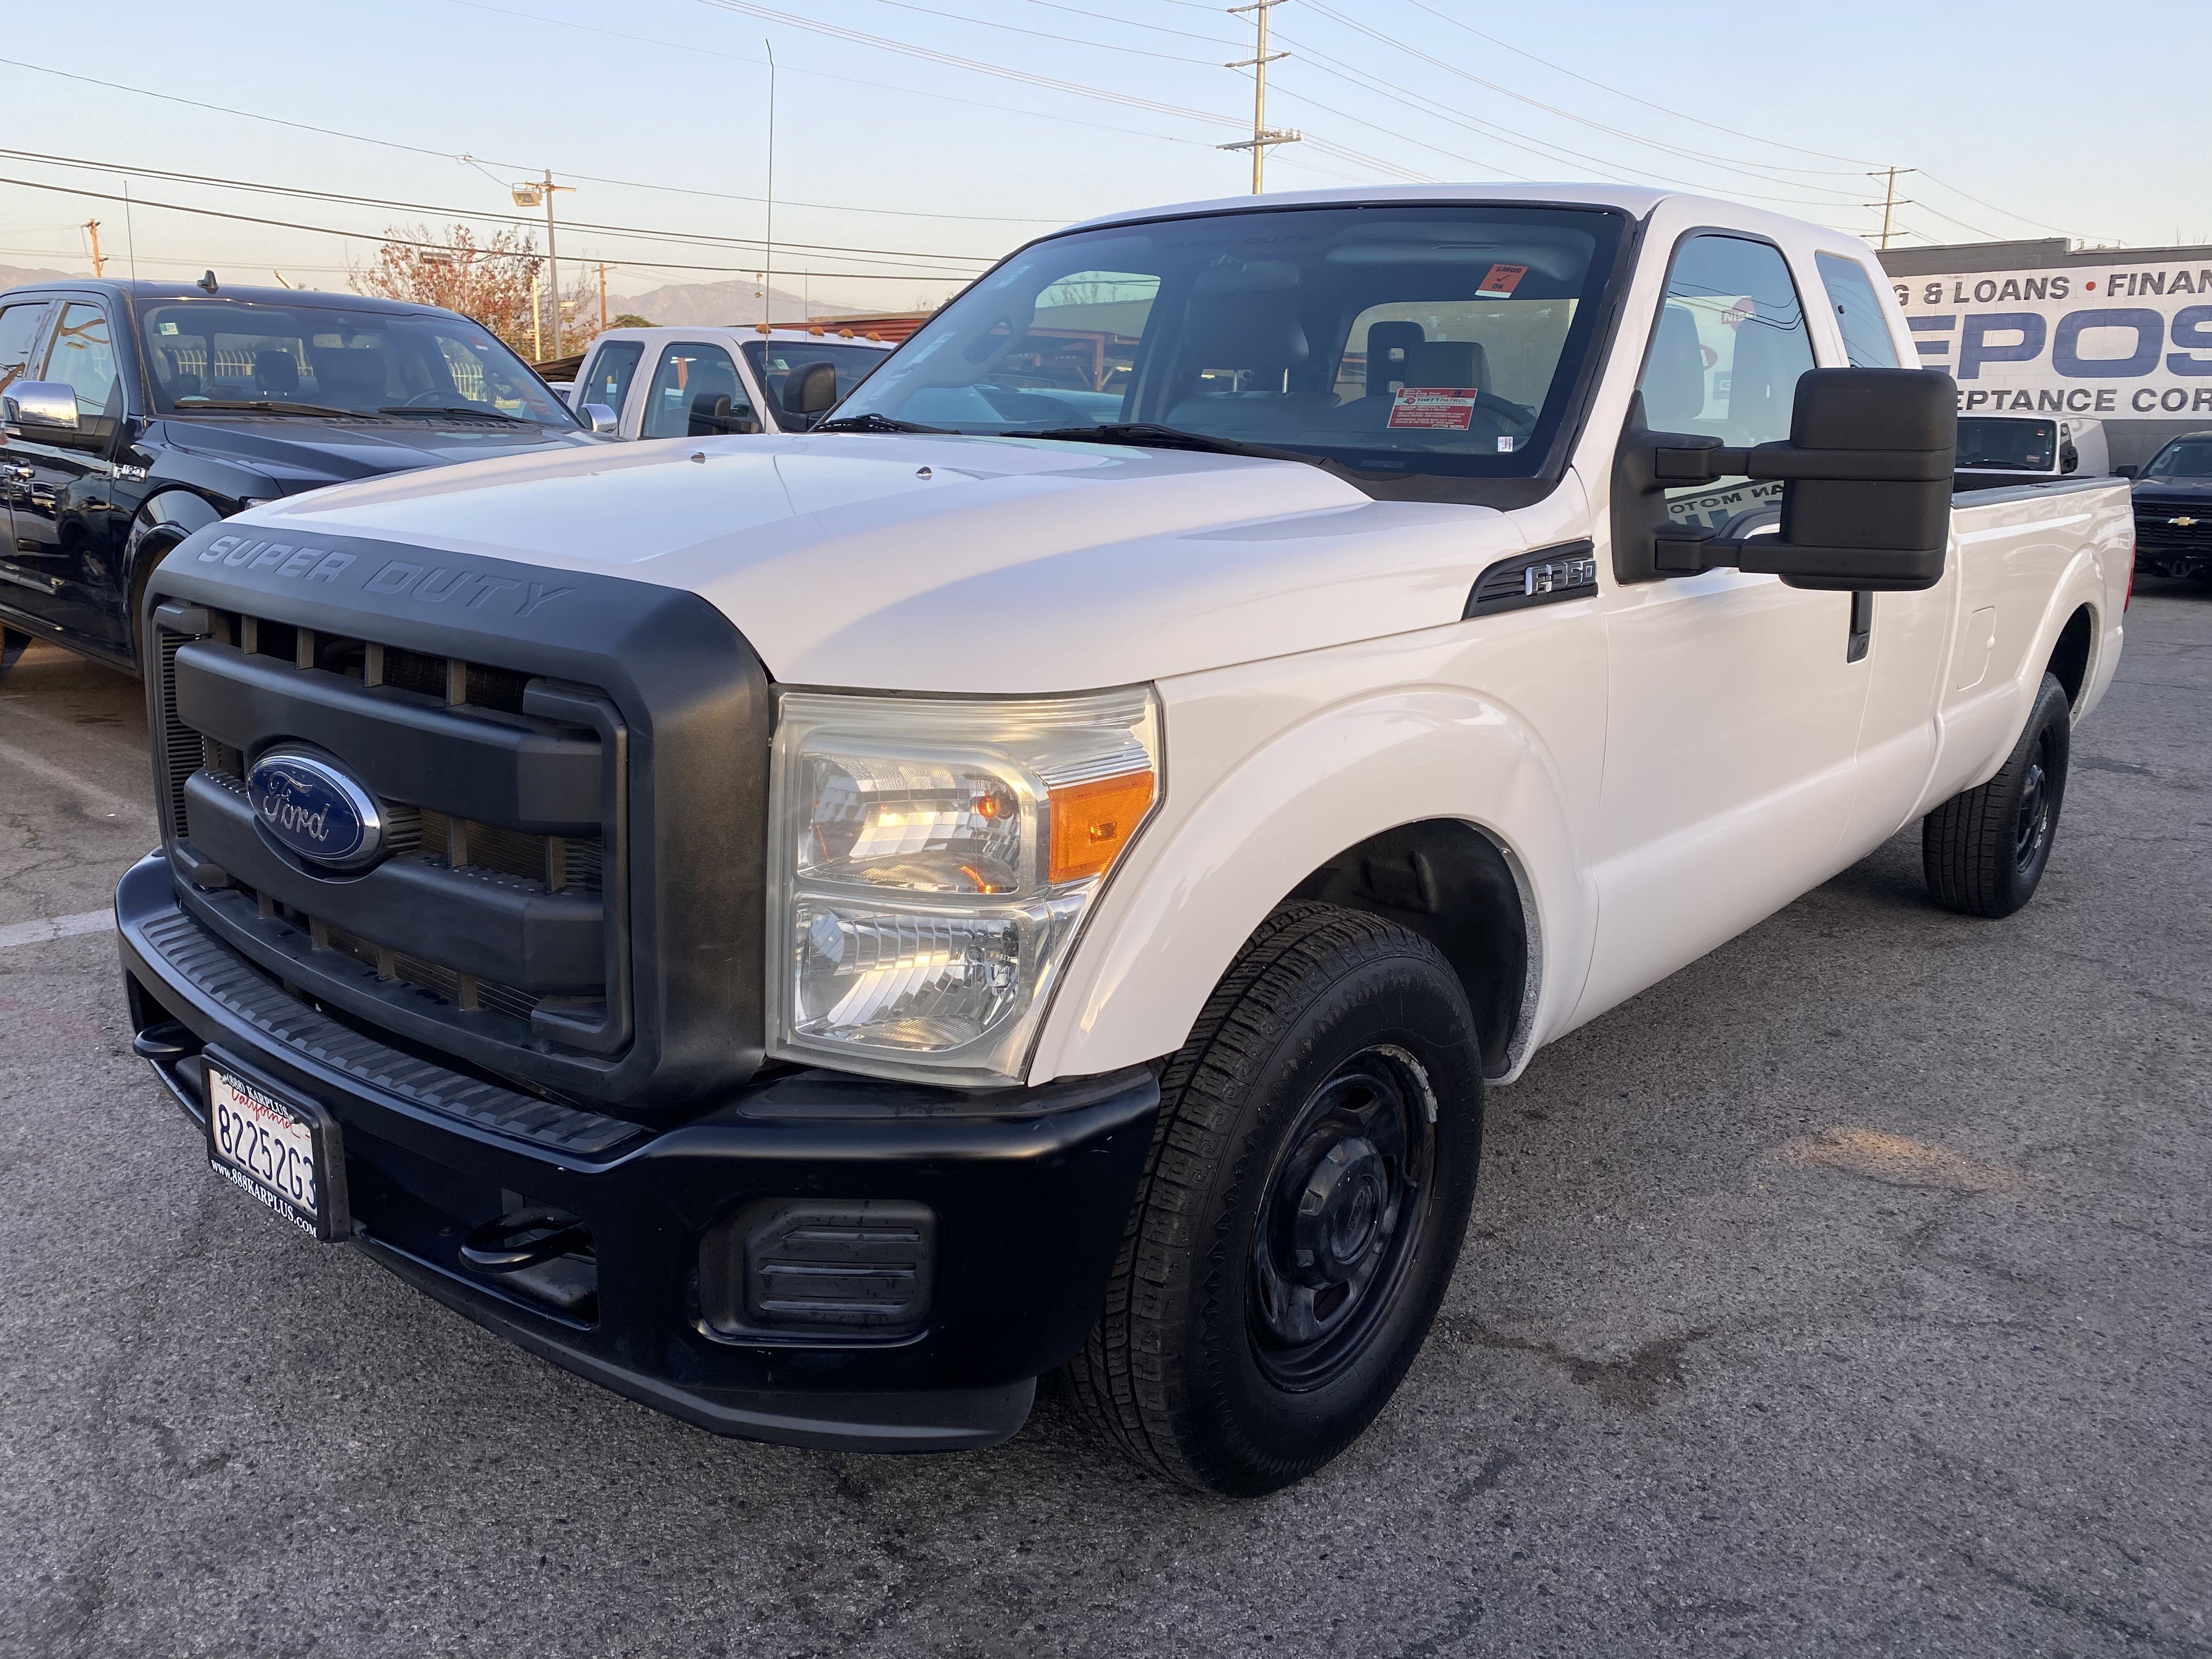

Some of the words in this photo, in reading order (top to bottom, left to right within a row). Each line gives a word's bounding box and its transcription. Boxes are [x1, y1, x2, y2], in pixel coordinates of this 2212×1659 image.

[1923, 282, 1943, 304] &
[1954, 276, 2070, 303] LOANS
[1957, 388, 2118, 412] PTANCE
[2132, 388, 2212, 412] COR
[198, 536, 358, 583] SUPER
[360, 559, 579, 617] DUTY
[263, 771, 331, 842] Ford
[227, 1073, 246, 1094] (888)
[246, 1085, 289, 1119] KARPLUS
[218, 1103, 318, 1210] 82252G3
